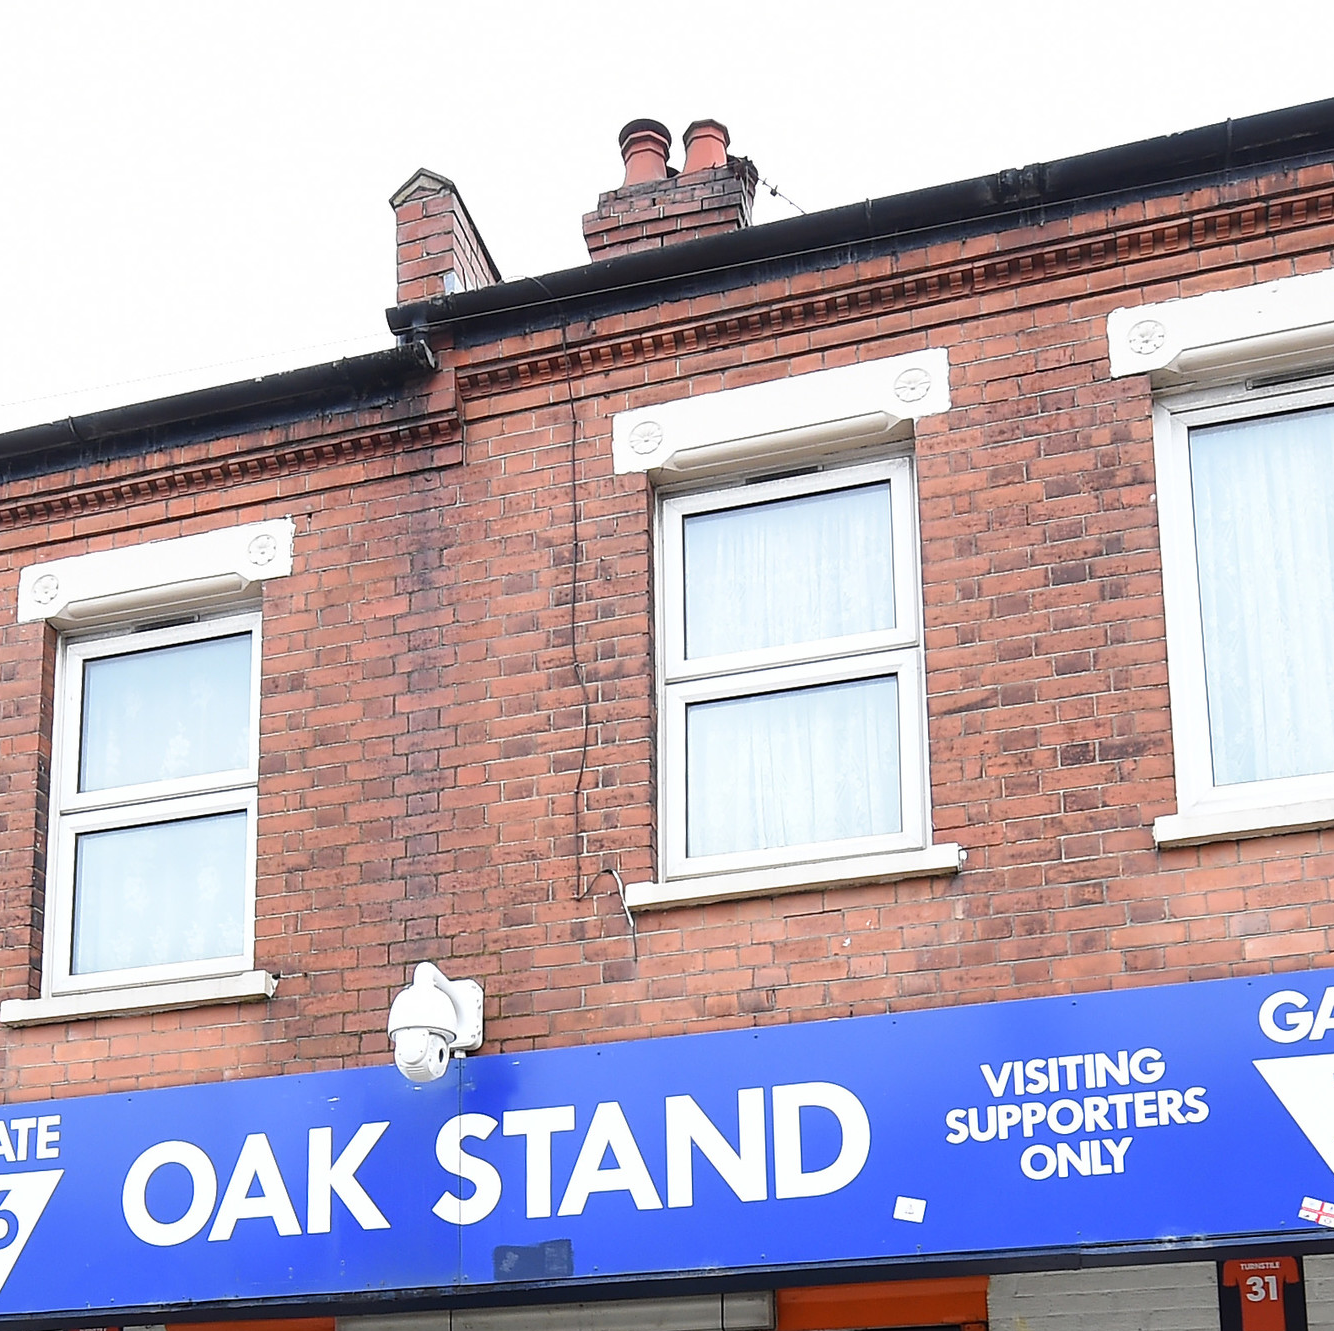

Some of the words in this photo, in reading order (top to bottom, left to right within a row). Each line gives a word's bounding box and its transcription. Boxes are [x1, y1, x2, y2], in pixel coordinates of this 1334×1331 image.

[979, 1048, 1166, 1098] VISITING
[946, 1087, 1210, 1145] SUPPORTERS
[122, 1121, 392, 1246] OAK
[431, 1081, 872, 1226] STAND
[1020, 1137, 1134, 1181] ONLY
[1240, 1261, 1280, 1270] TURNSTILE
[1246, 1275, 1278, 1302] 31
